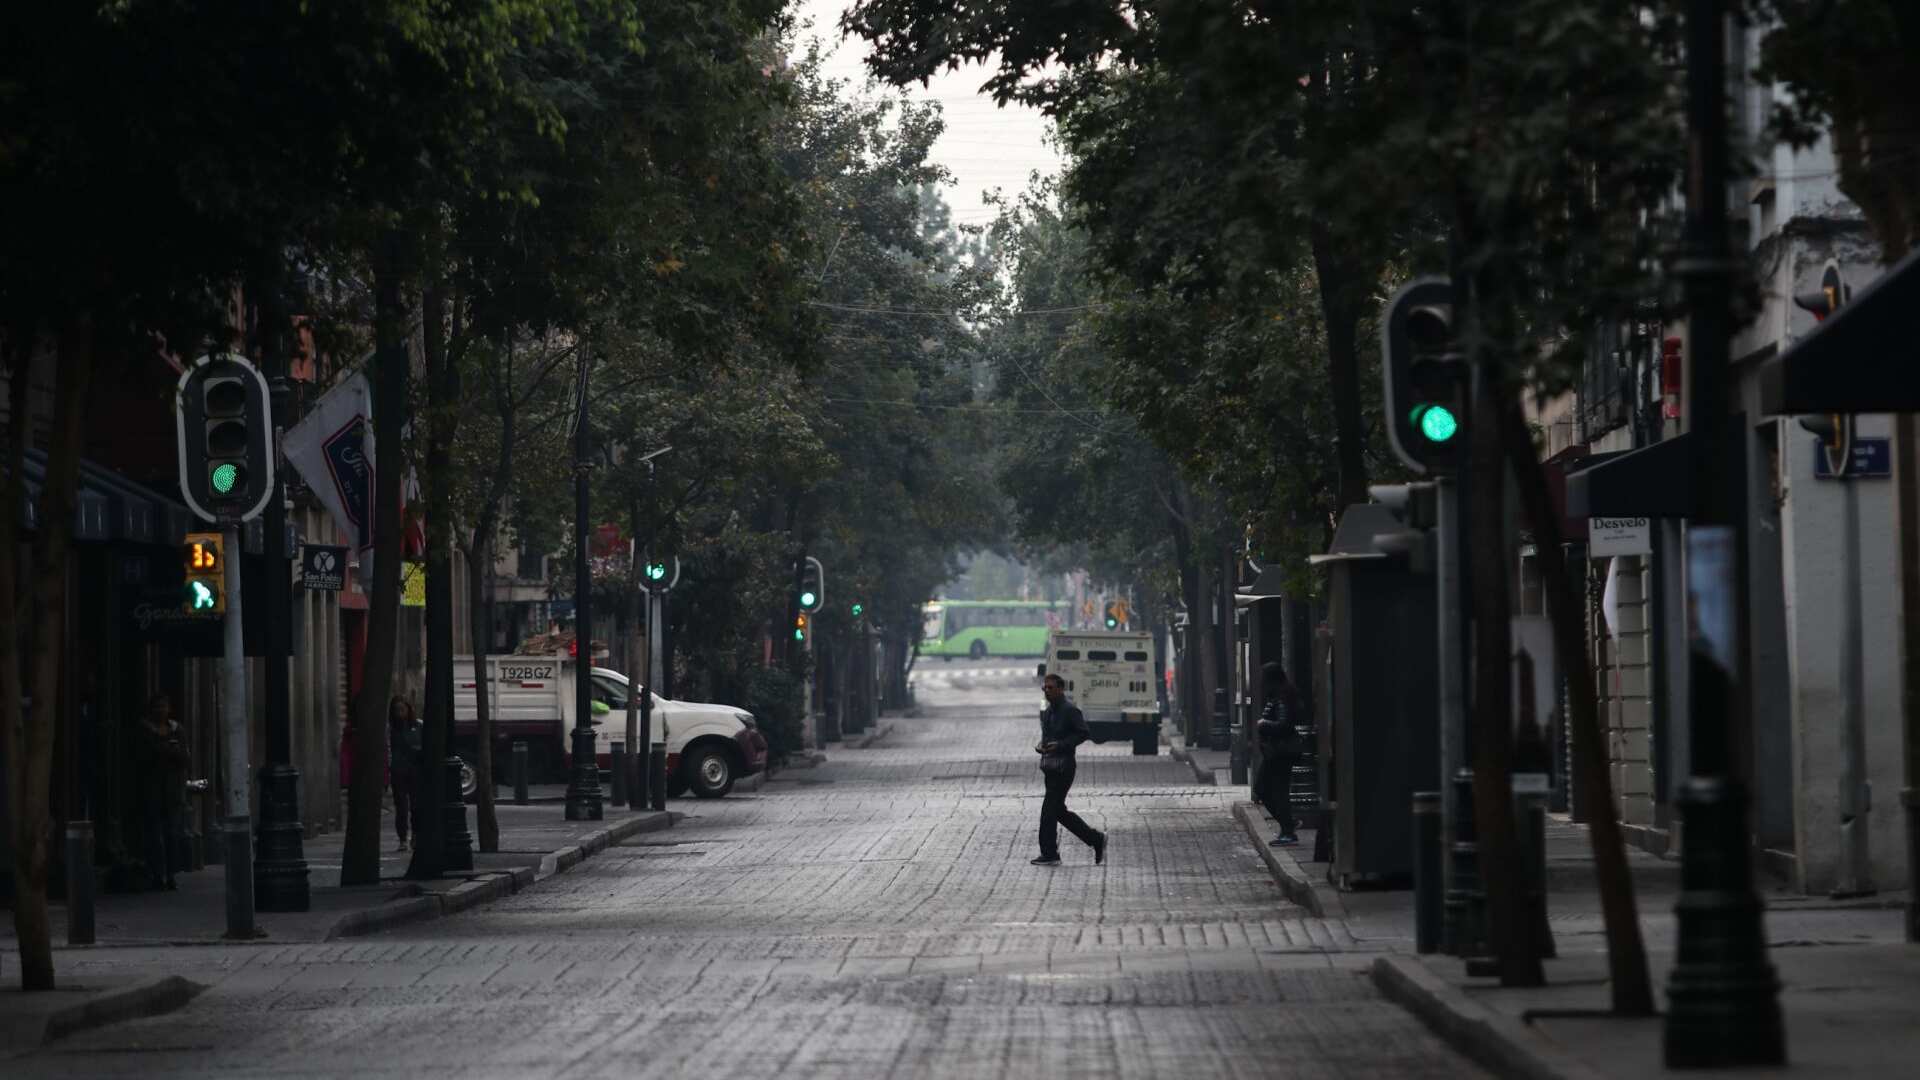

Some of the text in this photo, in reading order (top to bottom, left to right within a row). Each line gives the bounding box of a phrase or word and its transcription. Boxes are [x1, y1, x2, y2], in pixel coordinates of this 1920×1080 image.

[1594, 517, 1647, 529] Desvelo
[304, 571, 342, 583] San Pablo
[500, 667, 552, 680] T92BGZ
